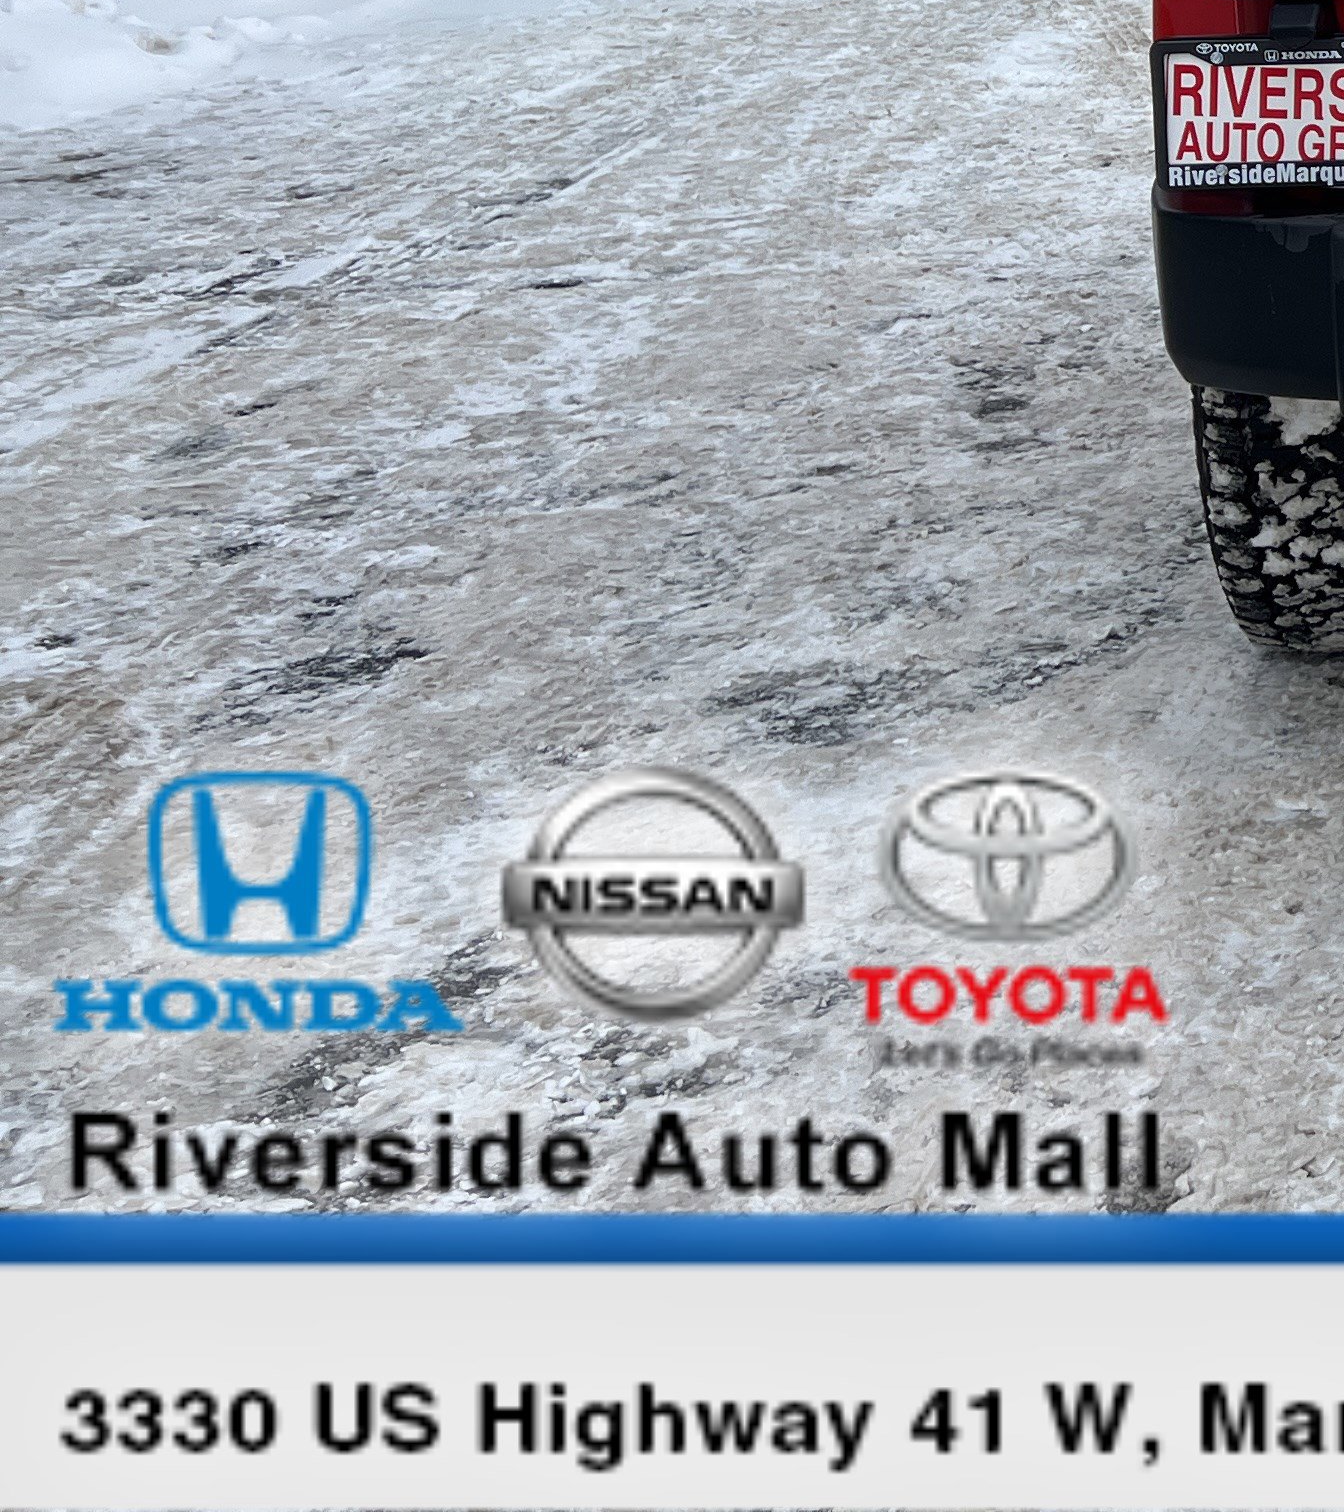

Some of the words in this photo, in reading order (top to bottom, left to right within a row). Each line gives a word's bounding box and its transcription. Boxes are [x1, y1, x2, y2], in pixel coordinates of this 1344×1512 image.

[1213, 42, 1259, 54] TOYOTA
[1280, 49, 1343, 61] HONDA
[1175, 120, 1286, 163] AUTO
